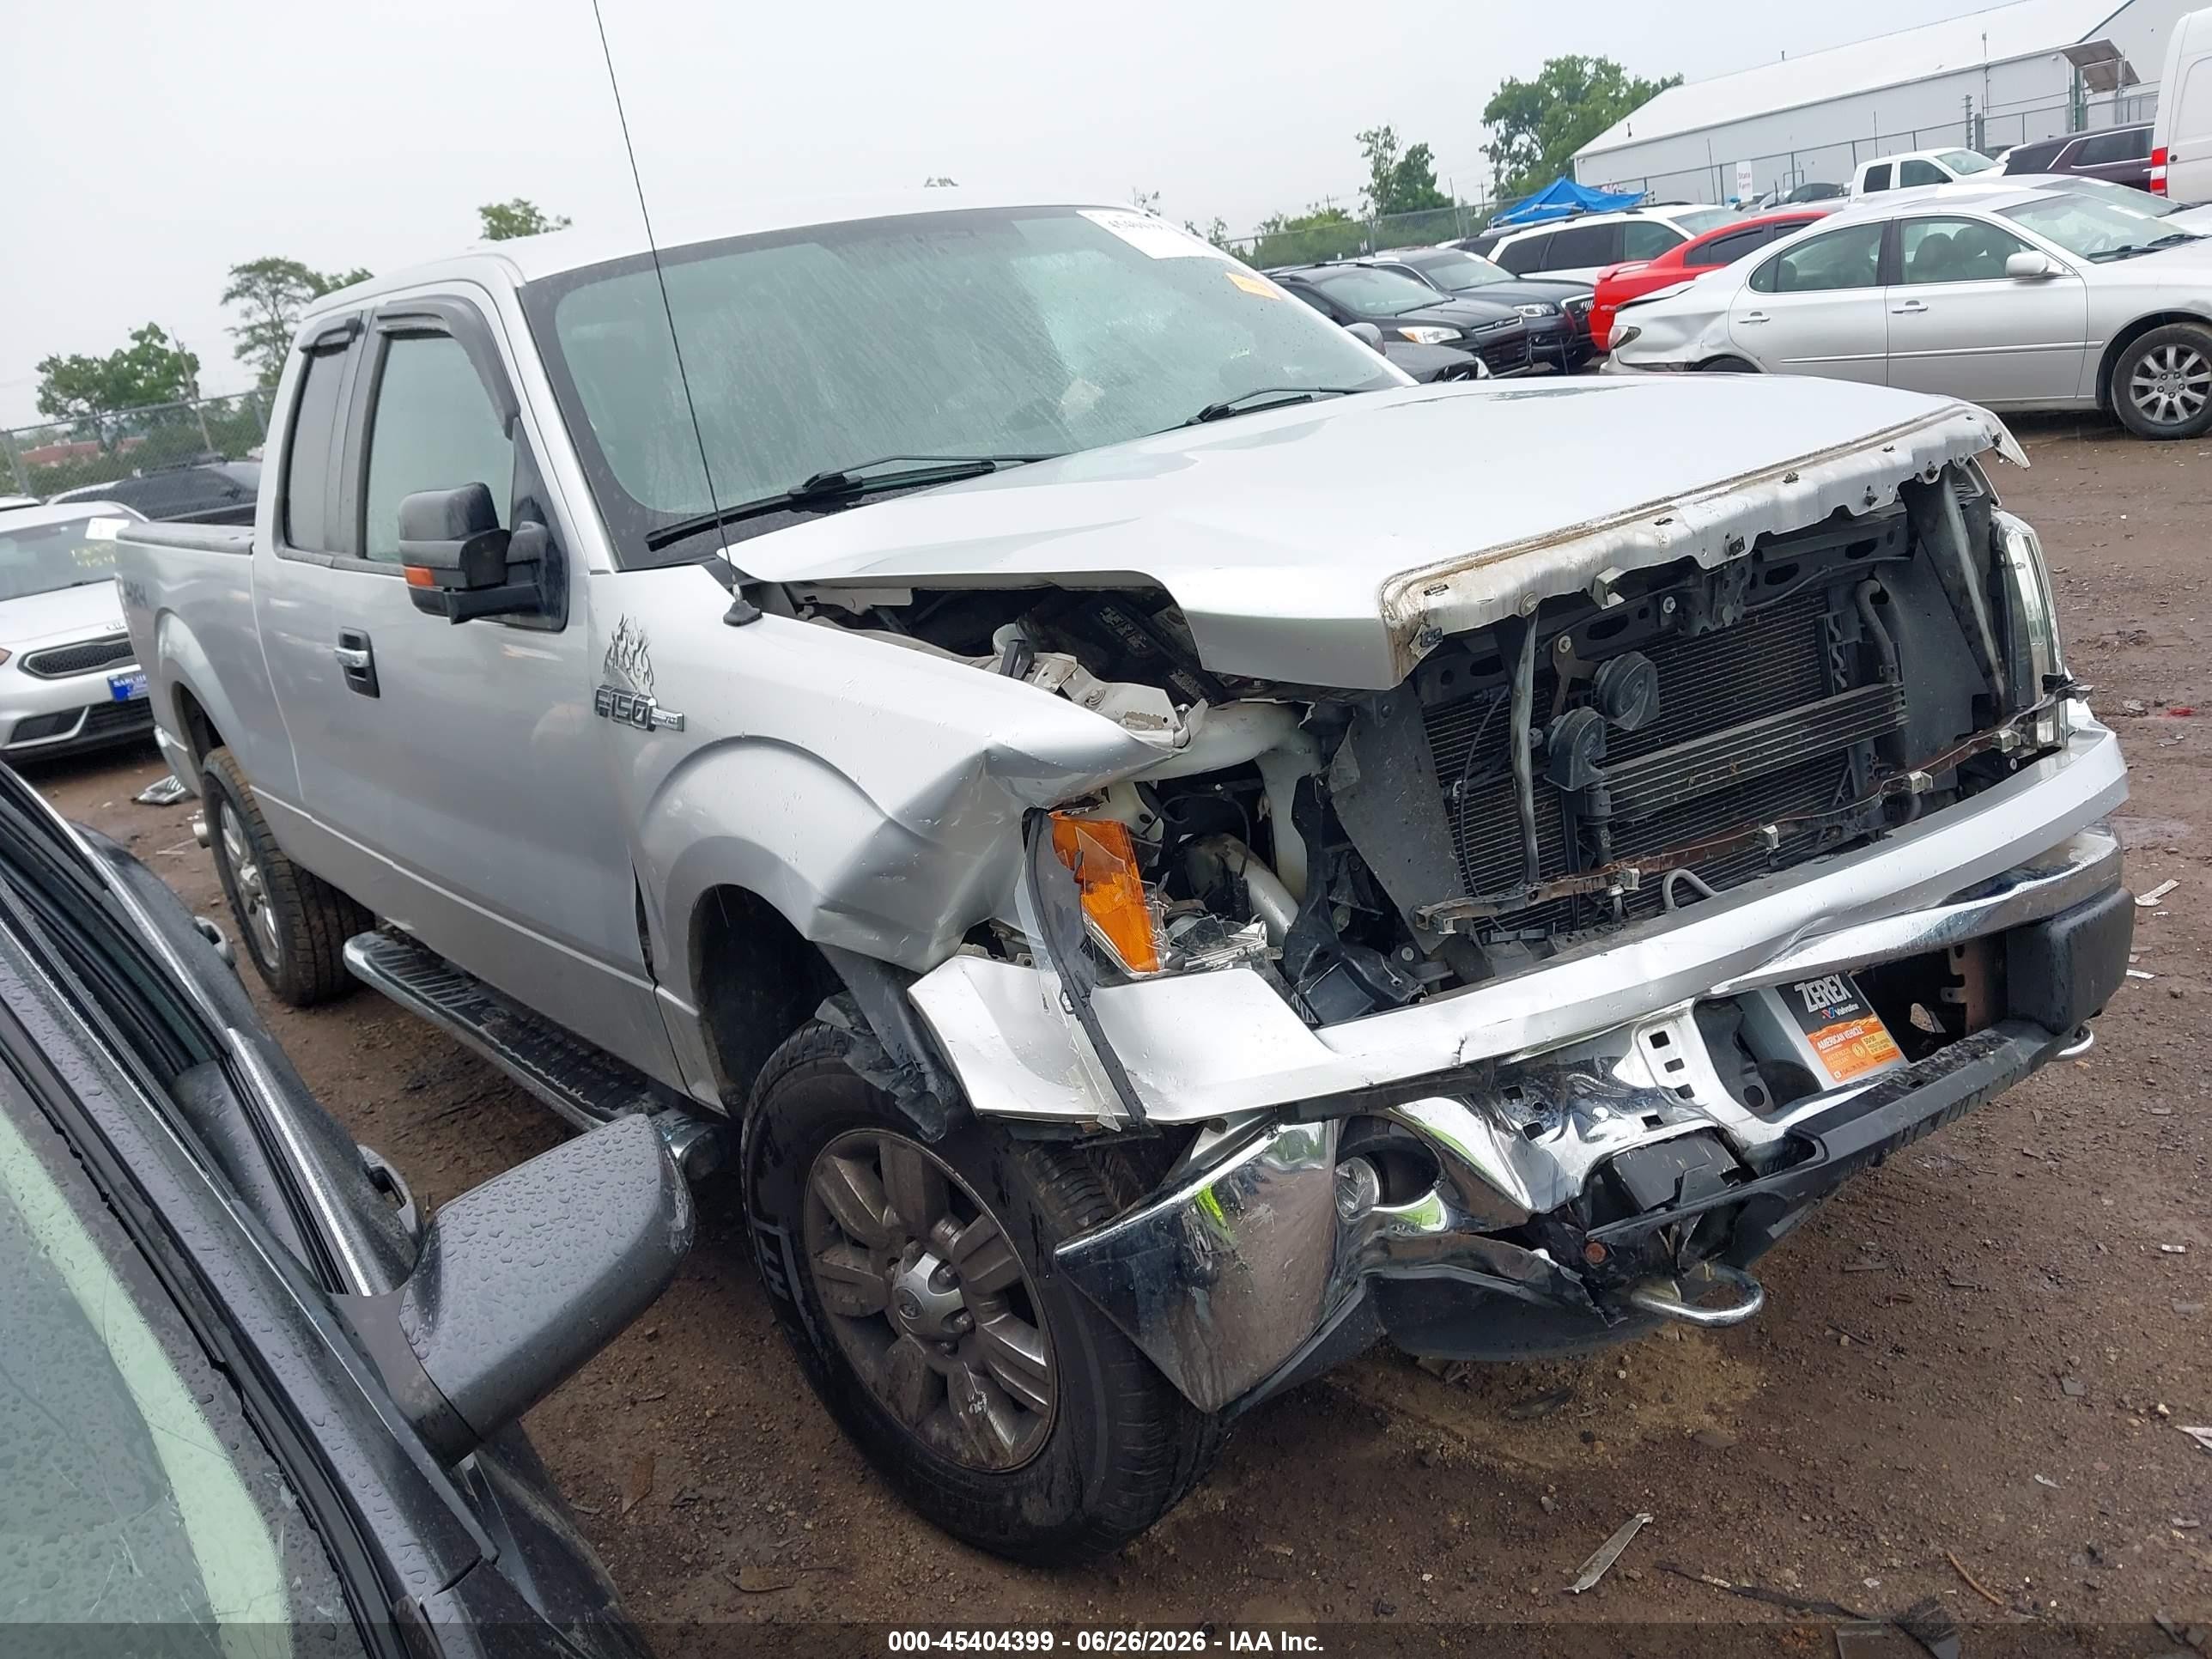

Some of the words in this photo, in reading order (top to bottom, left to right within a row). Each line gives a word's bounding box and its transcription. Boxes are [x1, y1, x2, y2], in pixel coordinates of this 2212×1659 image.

[1794, 975, 1852, 1013] ZEREX
[1835, 1003, 1860, 1017] Valvoline
[1817, 1034, 1844, 1049] AMERICAN
[1844, 1026, 1864, 1041] VEHICLE
